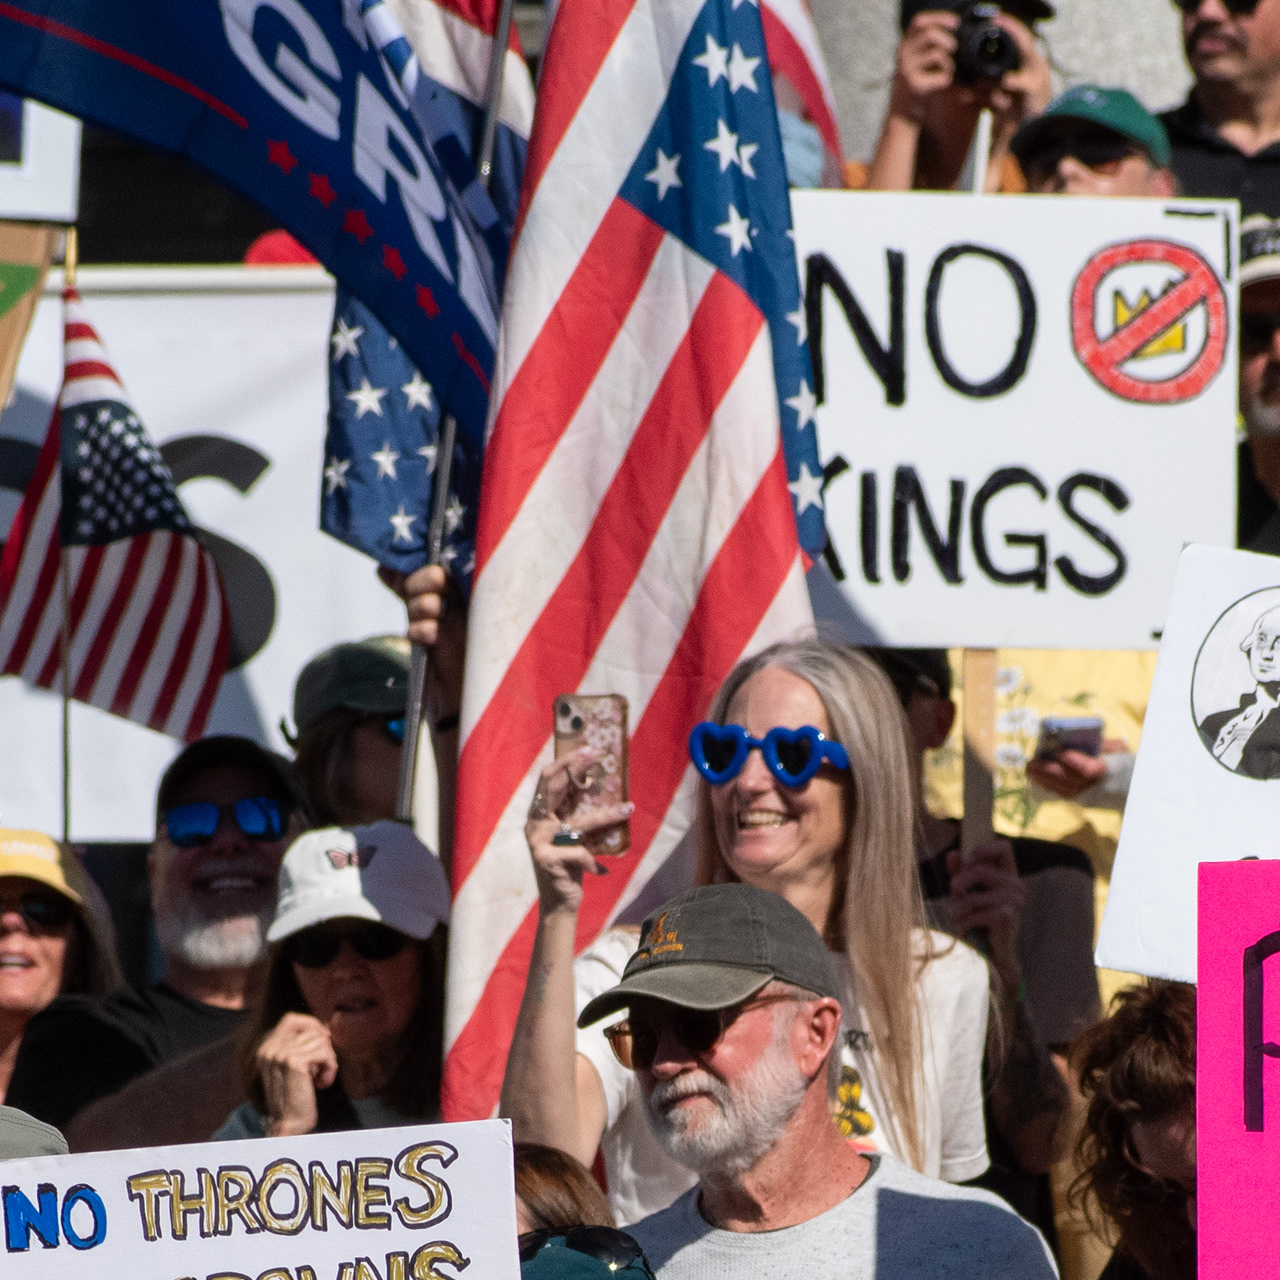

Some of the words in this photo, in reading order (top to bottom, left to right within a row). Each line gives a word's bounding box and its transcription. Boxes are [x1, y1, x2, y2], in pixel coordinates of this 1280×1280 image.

[804, 243, 1037, 407] NO
[2, 1182, 108, 1253] NO
[127, 1140, 459, 1243] THRONES
